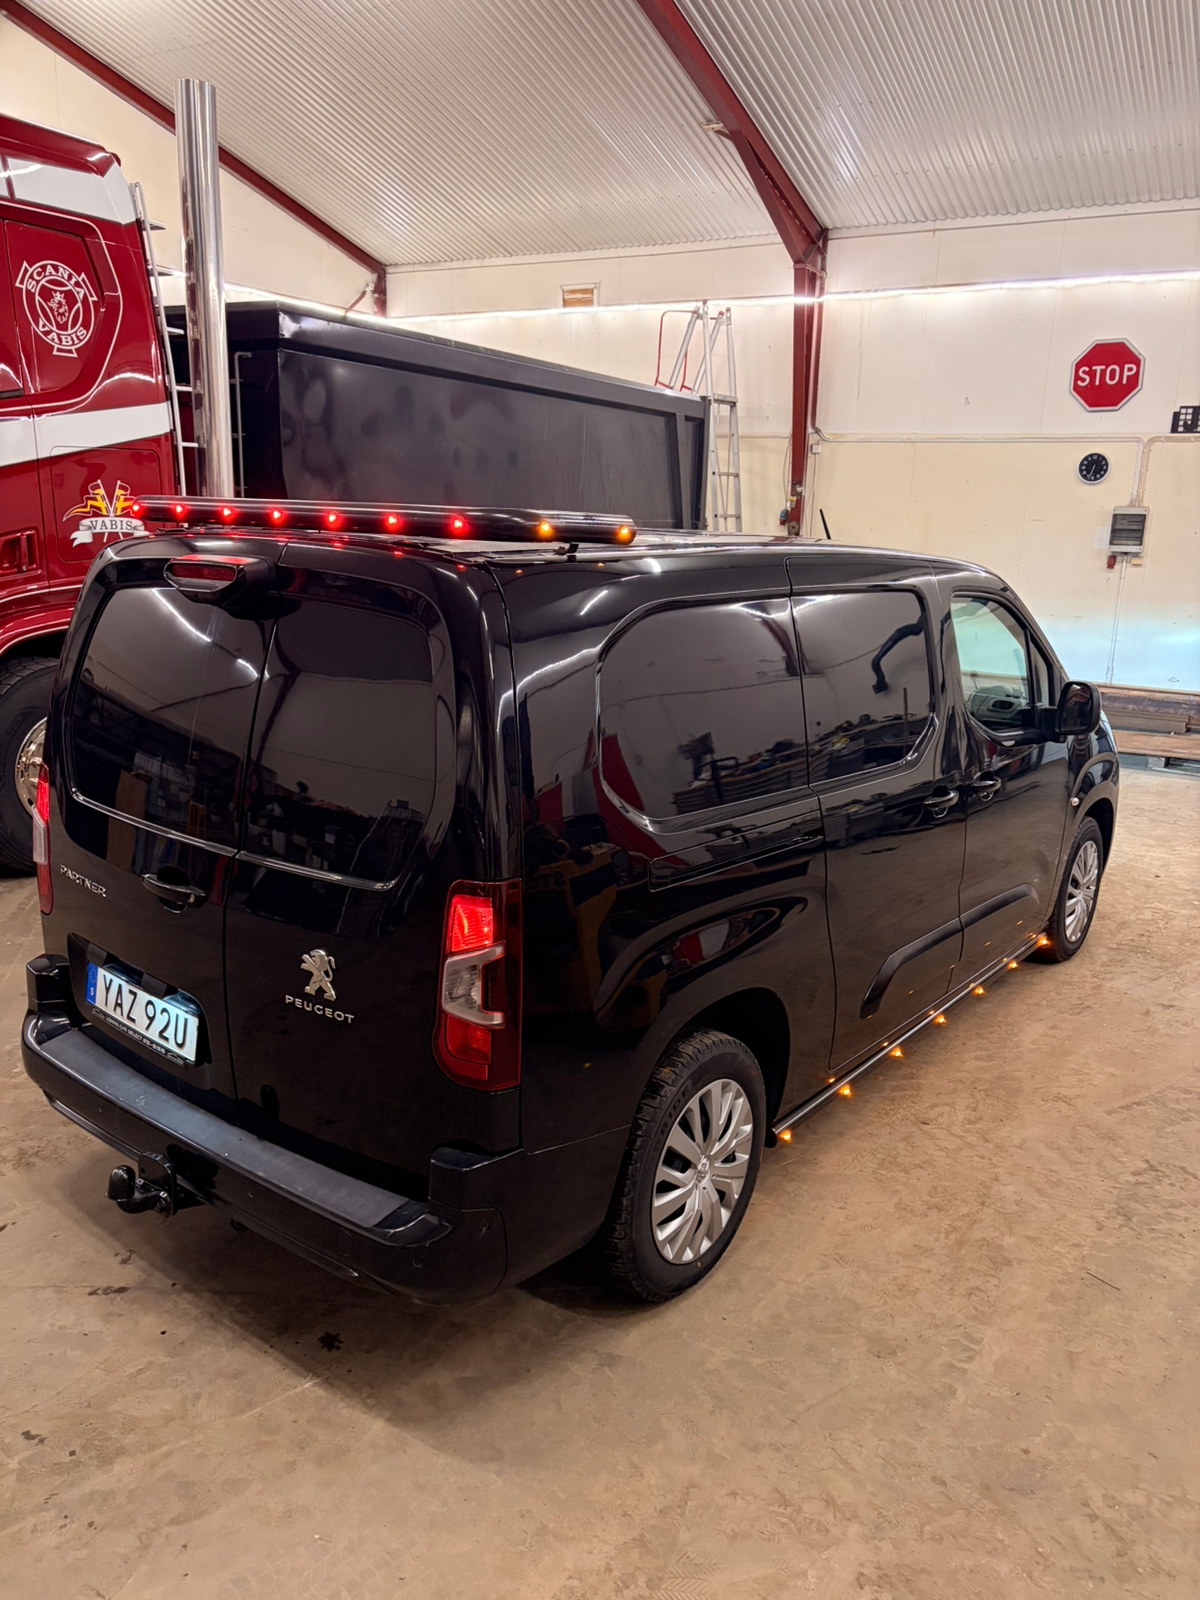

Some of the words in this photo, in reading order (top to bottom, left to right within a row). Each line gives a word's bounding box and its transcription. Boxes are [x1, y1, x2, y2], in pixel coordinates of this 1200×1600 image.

[26, 264, 85, 301] SCANIA
[38, 317, 87, 345] VABIS
[1077, 364, 1137, 386] STOP
[89, 519, 133, 531] VABIS
[60, 864, 106, 897] PARTNER
[103, 974, 138, 1025] YAZ
[145, 999, 188, 1049] 92U
[285, 994, 355, 1024] PEUGEOT
